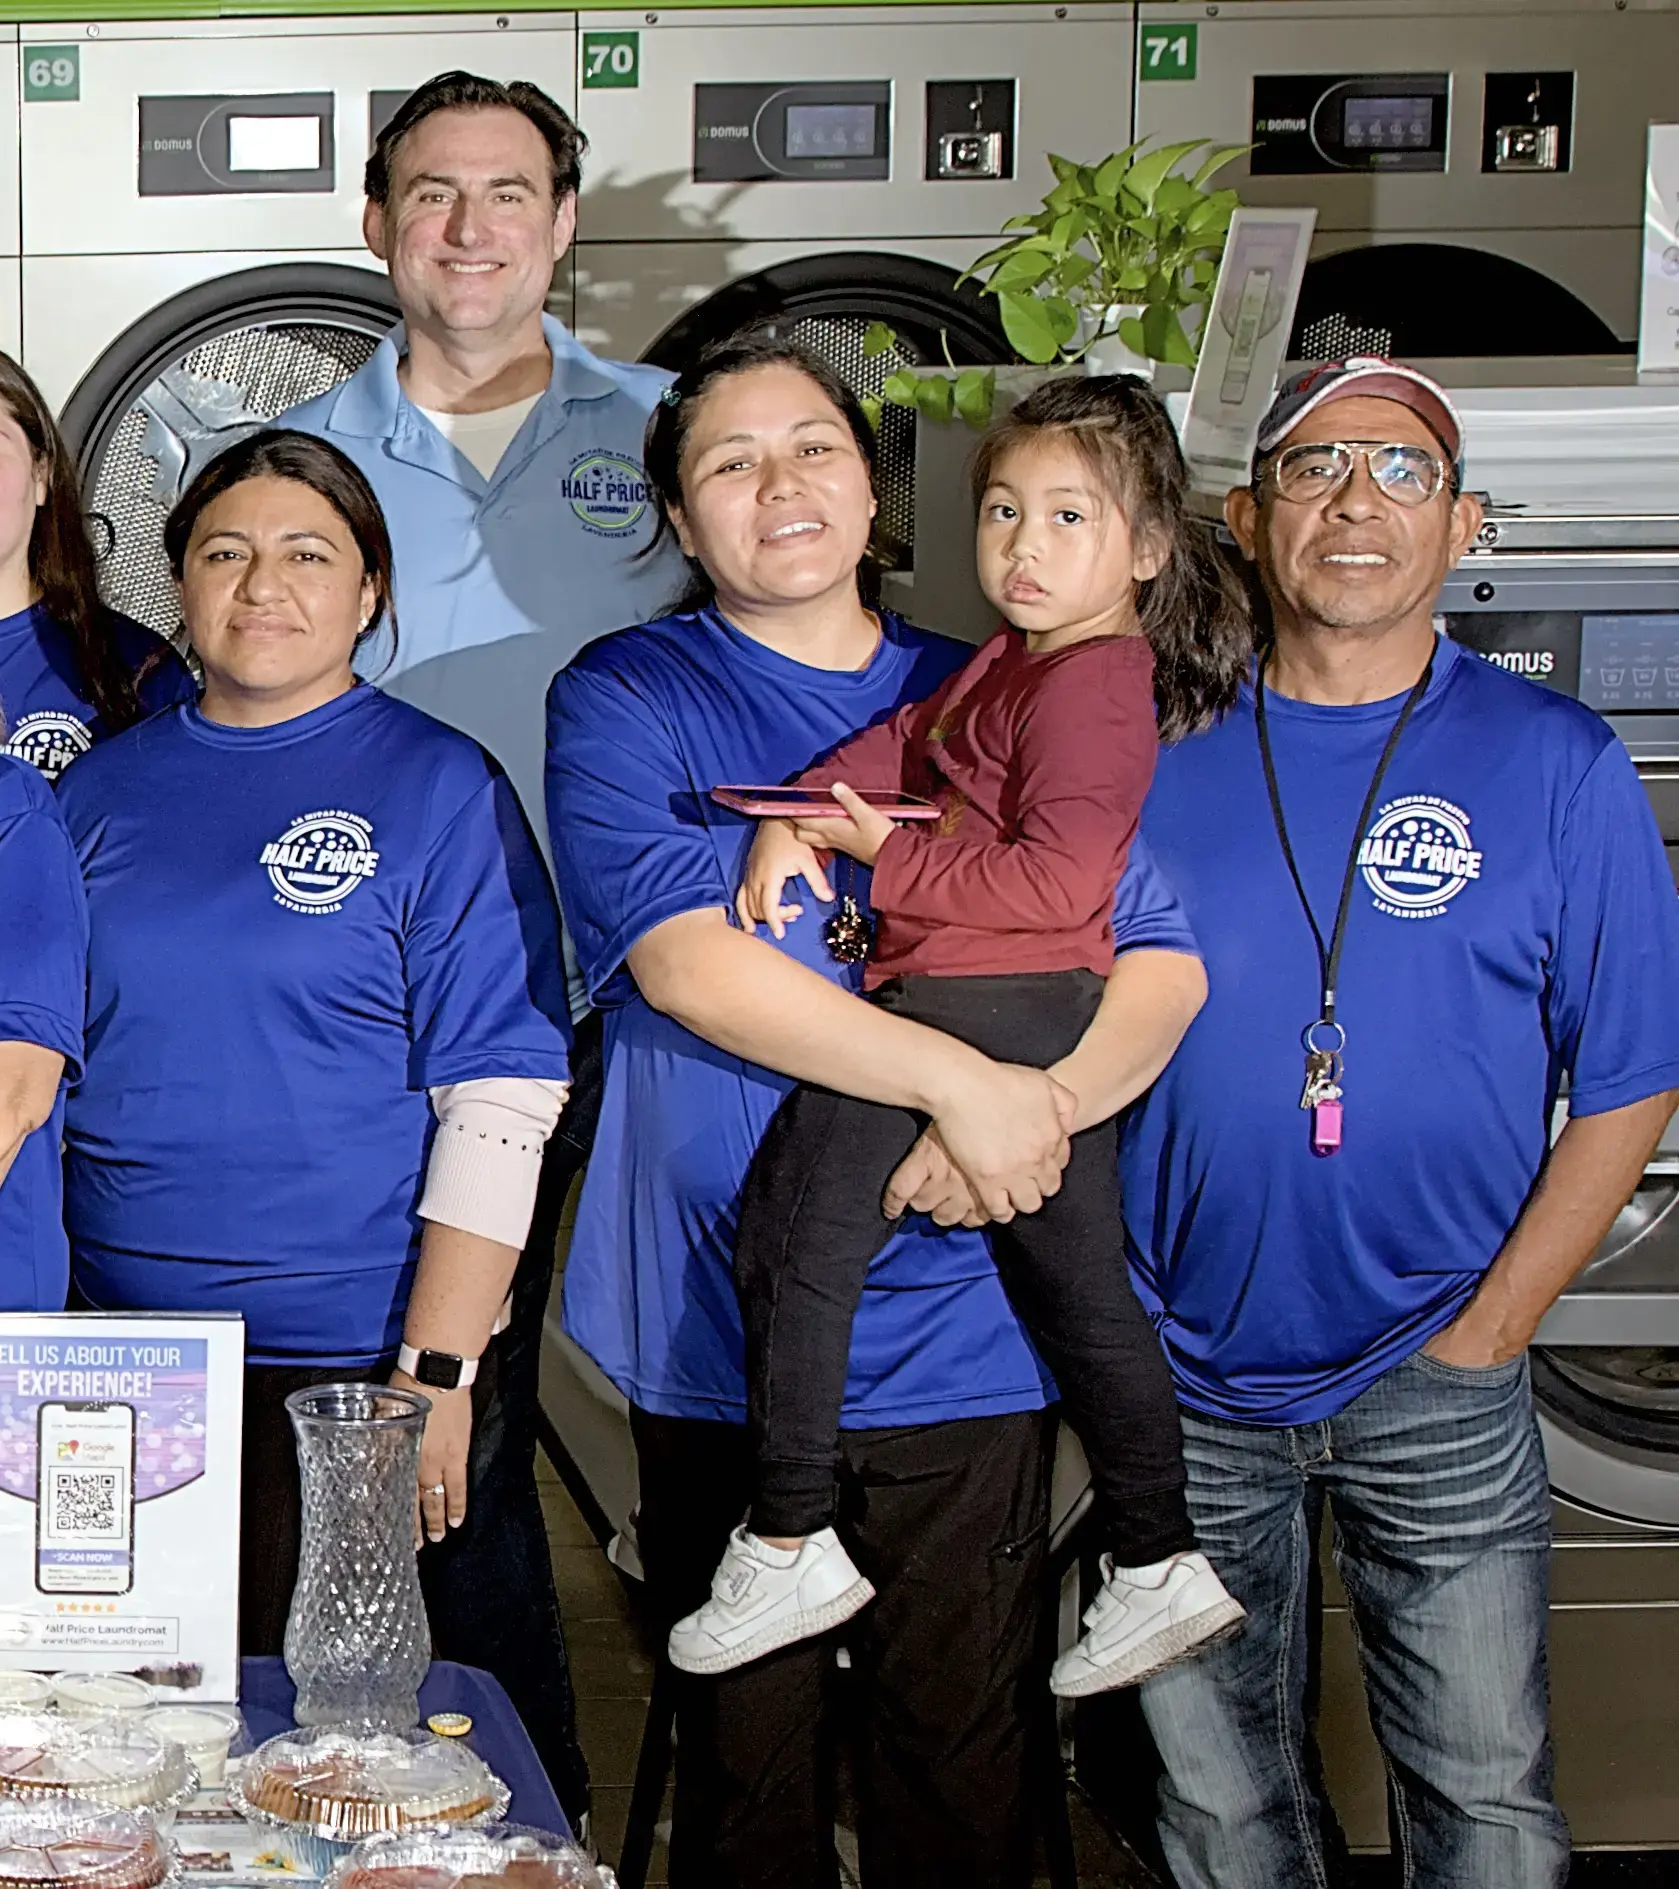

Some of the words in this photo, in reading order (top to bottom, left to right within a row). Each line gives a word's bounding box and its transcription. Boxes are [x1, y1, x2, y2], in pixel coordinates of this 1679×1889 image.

[587, 44, 633, 74] 70
[1145, 36, 1189, 68] 71
[28, 58, 75, 87] 69
[710, 126, 749, 139] DOMUS
[1267, 118, 1308, 132] DOMUS
[153, 138, 192, 152] DOMUS
[561, 479, 601, 501] HALF
[259, 843, 316, 869] HALF
[315, 848, 380, 877] PRICE
[1356, 838, 1412, 867] HALF
[1411, 842, 1483, 880] PRICE
[34, 1345, 59, 1365] US
[64, 1346, 126, 1366] ABOUT
[131, 1347, 181, 1367] YOUR
[18, 1369, 152, 1398] EXPERIENCE!
[56, 1552, 85, 1563] SCAN
[67, 1624, 95, 1634] Price
[98, 1624, 167, 1636] Laundromat
